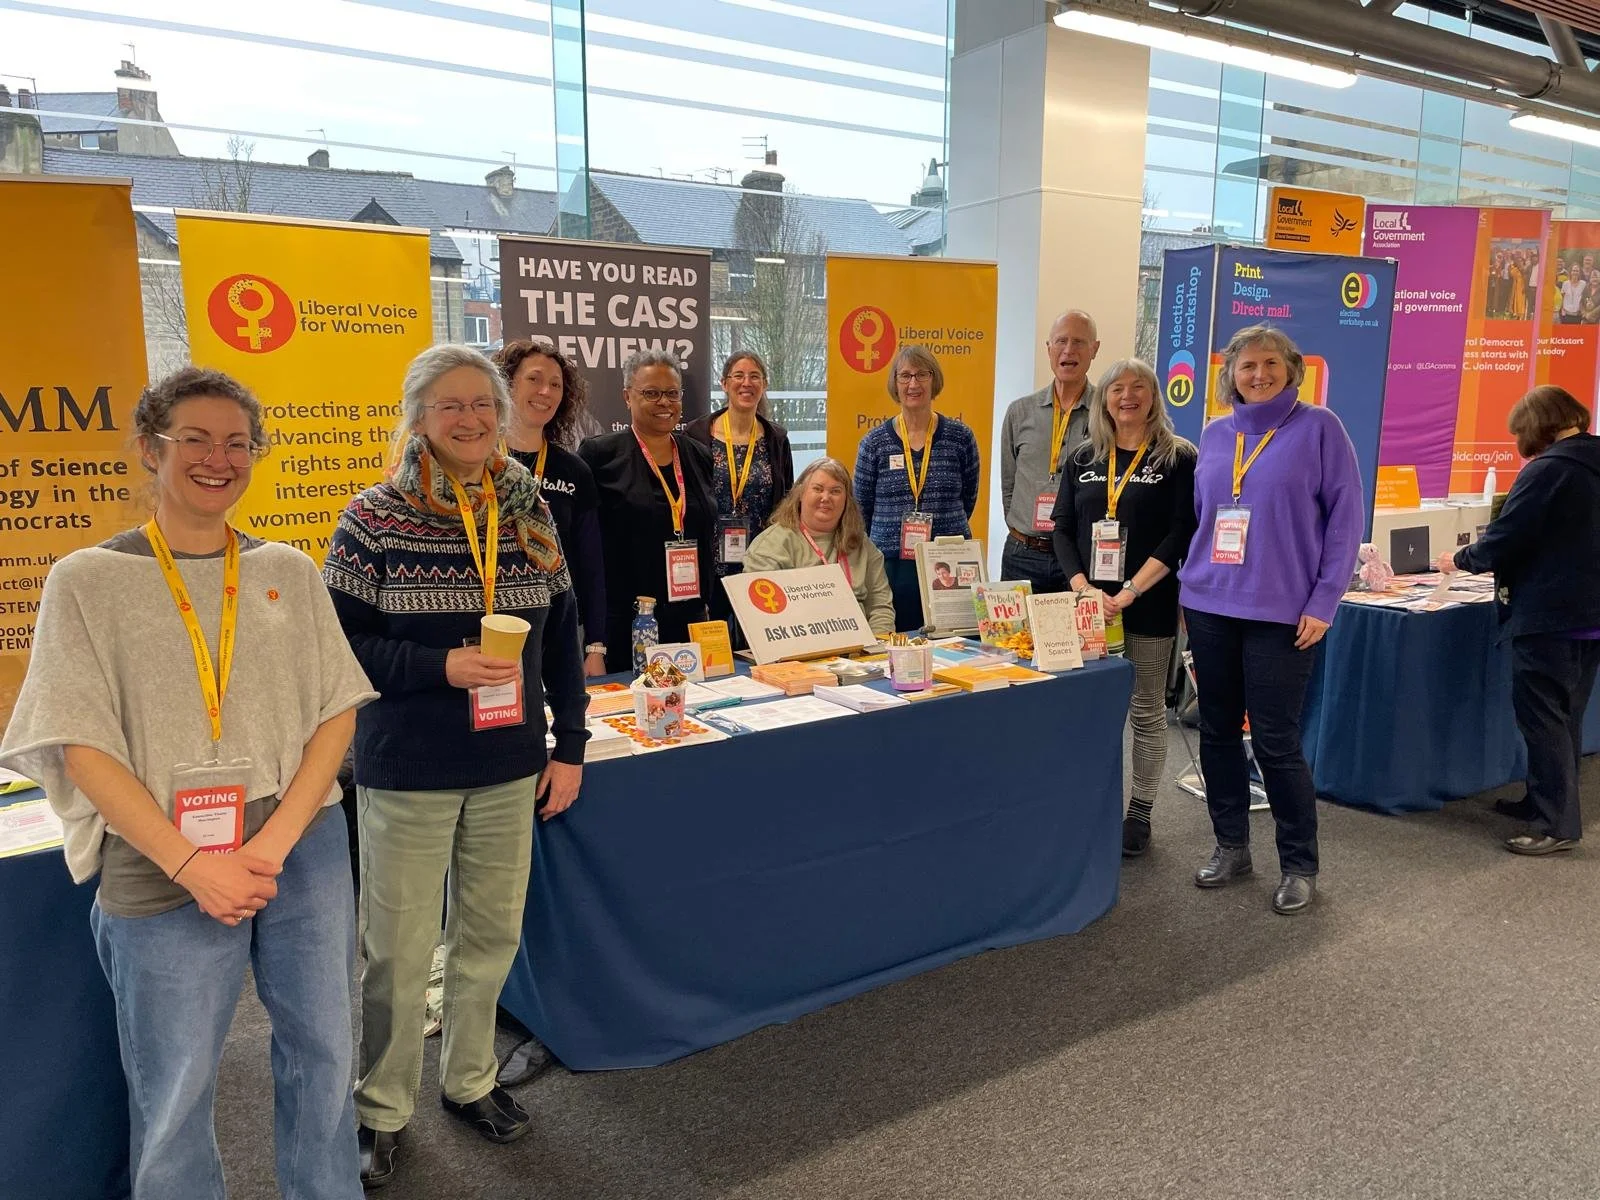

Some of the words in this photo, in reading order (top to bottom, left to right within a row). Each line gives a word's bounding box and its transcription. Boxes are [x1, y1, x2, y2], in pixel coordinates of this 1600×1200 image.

[1277, 215, 1312, 227] Government
[1374, 219, 1396, 228] Local
[1373, 231, 1425, 241] Government
[518, 257, 582, 281] HAVE
[586, 262, 636, 284] YOU
[643, 265, 697, 287] READ
[1235, 263, 1264, 279] Print.
[1233, 282, 1271, 301] Design.
[1430, 291, 1456, 300] voice
[299, 299, 362, 317] Liberal
[367, 303, 418, 319] Voice
[520, 289, 596, 326] THE
[607, 294, 698, 330] CASS
[1185, 266, 1201, 347] workshop
[1232, 300, 1263, 317] Direct
[1267, 304, 1292, 318] mail.
[1393, 303, 1402, 312] al
[1404, 304, 1463, 316] government
[1171, 282, 1185, 347] election
[300, 317, 327, 332] for
[331, 319, 405, 335] Women
[899, 326, 943, 340] Liberal
[947, 328, 984, 341] Voice
[1465, 338, 1477, 346] ral
[1480, 338, 1524, 347] Democrat
[1481, 350, 1507, 358] starts
[1543, 348, 1565, 356] today
[1416, 363, 1456, 371] @LGAcomms
[1473, 362, 1492, 370] Join
[1495, 362, 1524, 372] today!
[263, 401, 360, 421] rotecting
[366, 400, 403, 417] and
[268, 427, 362, 446] dvancing
[0, 459, 20, 478] of
[31, 458, 128, 478] Science
[281, 454, 341, 476] rights
[347, 452, 383, 470] and
[1079, 471, 1107, 483] Can
[1129, 473, 1163, 484] talk?
[53, 485, 75, 502] in
[89, 484, 130, 502] the
[542, 477, 576, 495] talk?
[249, 509, 331, 528] women
[1215, 552, 1239, 560] VOTING
[672, 584, 697, 593] VOTING
[783, 583, 812, 594] Liberal
[813, 582, 835, 590] Voice
[787, 593, 800, 602] for
[800, 590, 833, 601] Women
[1034, 598, 1069, 606] Defending
[994, 602, 1021, 619] Me!
[764, 626, 791, 642] Ask
[790, 625, 807, 638] us
[808, 617, 859, 636] anything
[1076, 616, 1092, 630] LAY
[1044, 640, 1074, 648] Women's
[1048, 647, 1072, 656] Spaces
[479, 708, 518, 721] VOTING
[182, 792, 238, 807] VOTING
